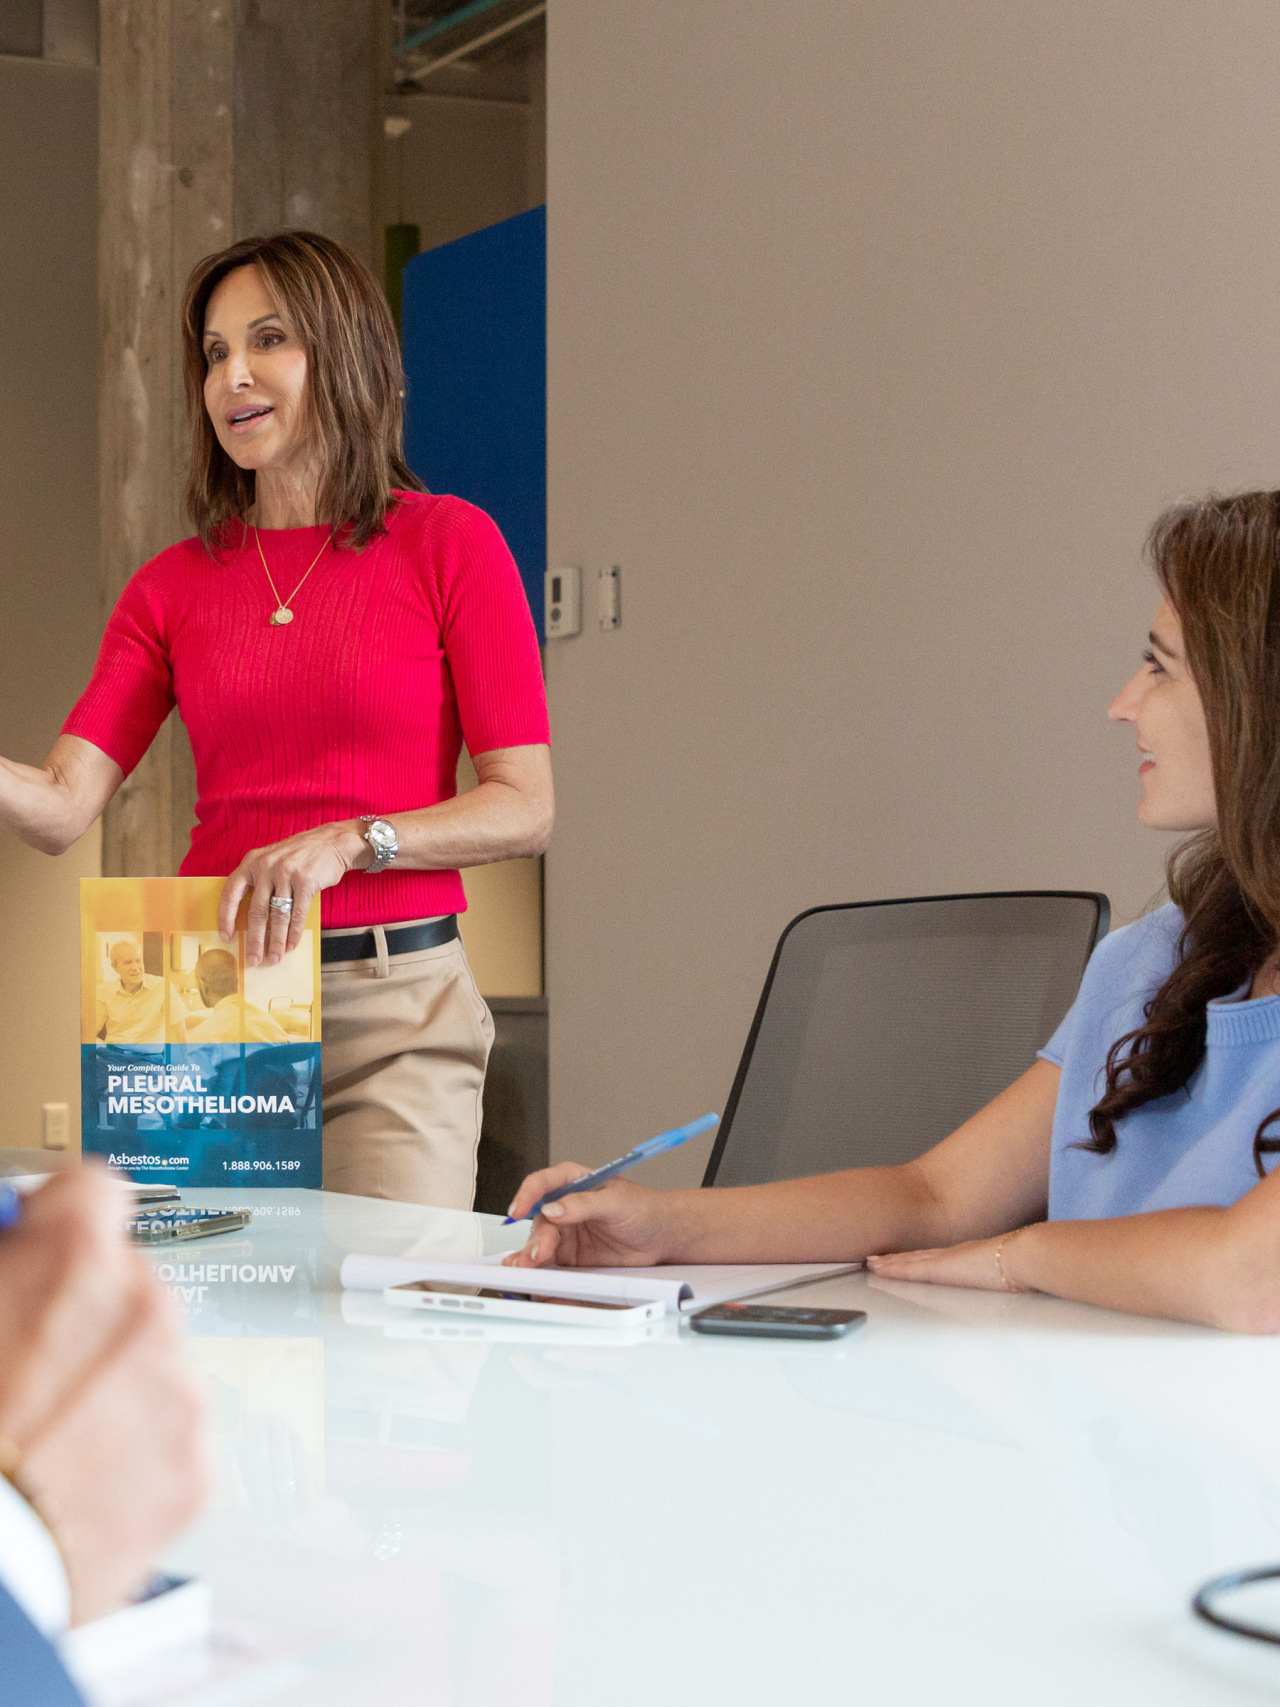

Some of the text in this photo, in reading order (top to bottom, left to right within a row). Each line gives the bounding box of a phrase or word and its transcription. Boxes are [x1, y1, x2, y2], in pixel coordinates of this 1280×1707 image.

[107, 1064, 200, 1073] Your Complete Guide To
[108, 1075, 207, 1093] PLEURAL
[108, 1095, 295, 1114] MESOTHELIOMA
[108, 1153, 189, 1166] Asbestos.com
[222, 1161, 301, 1171] 1.888.906.1589
